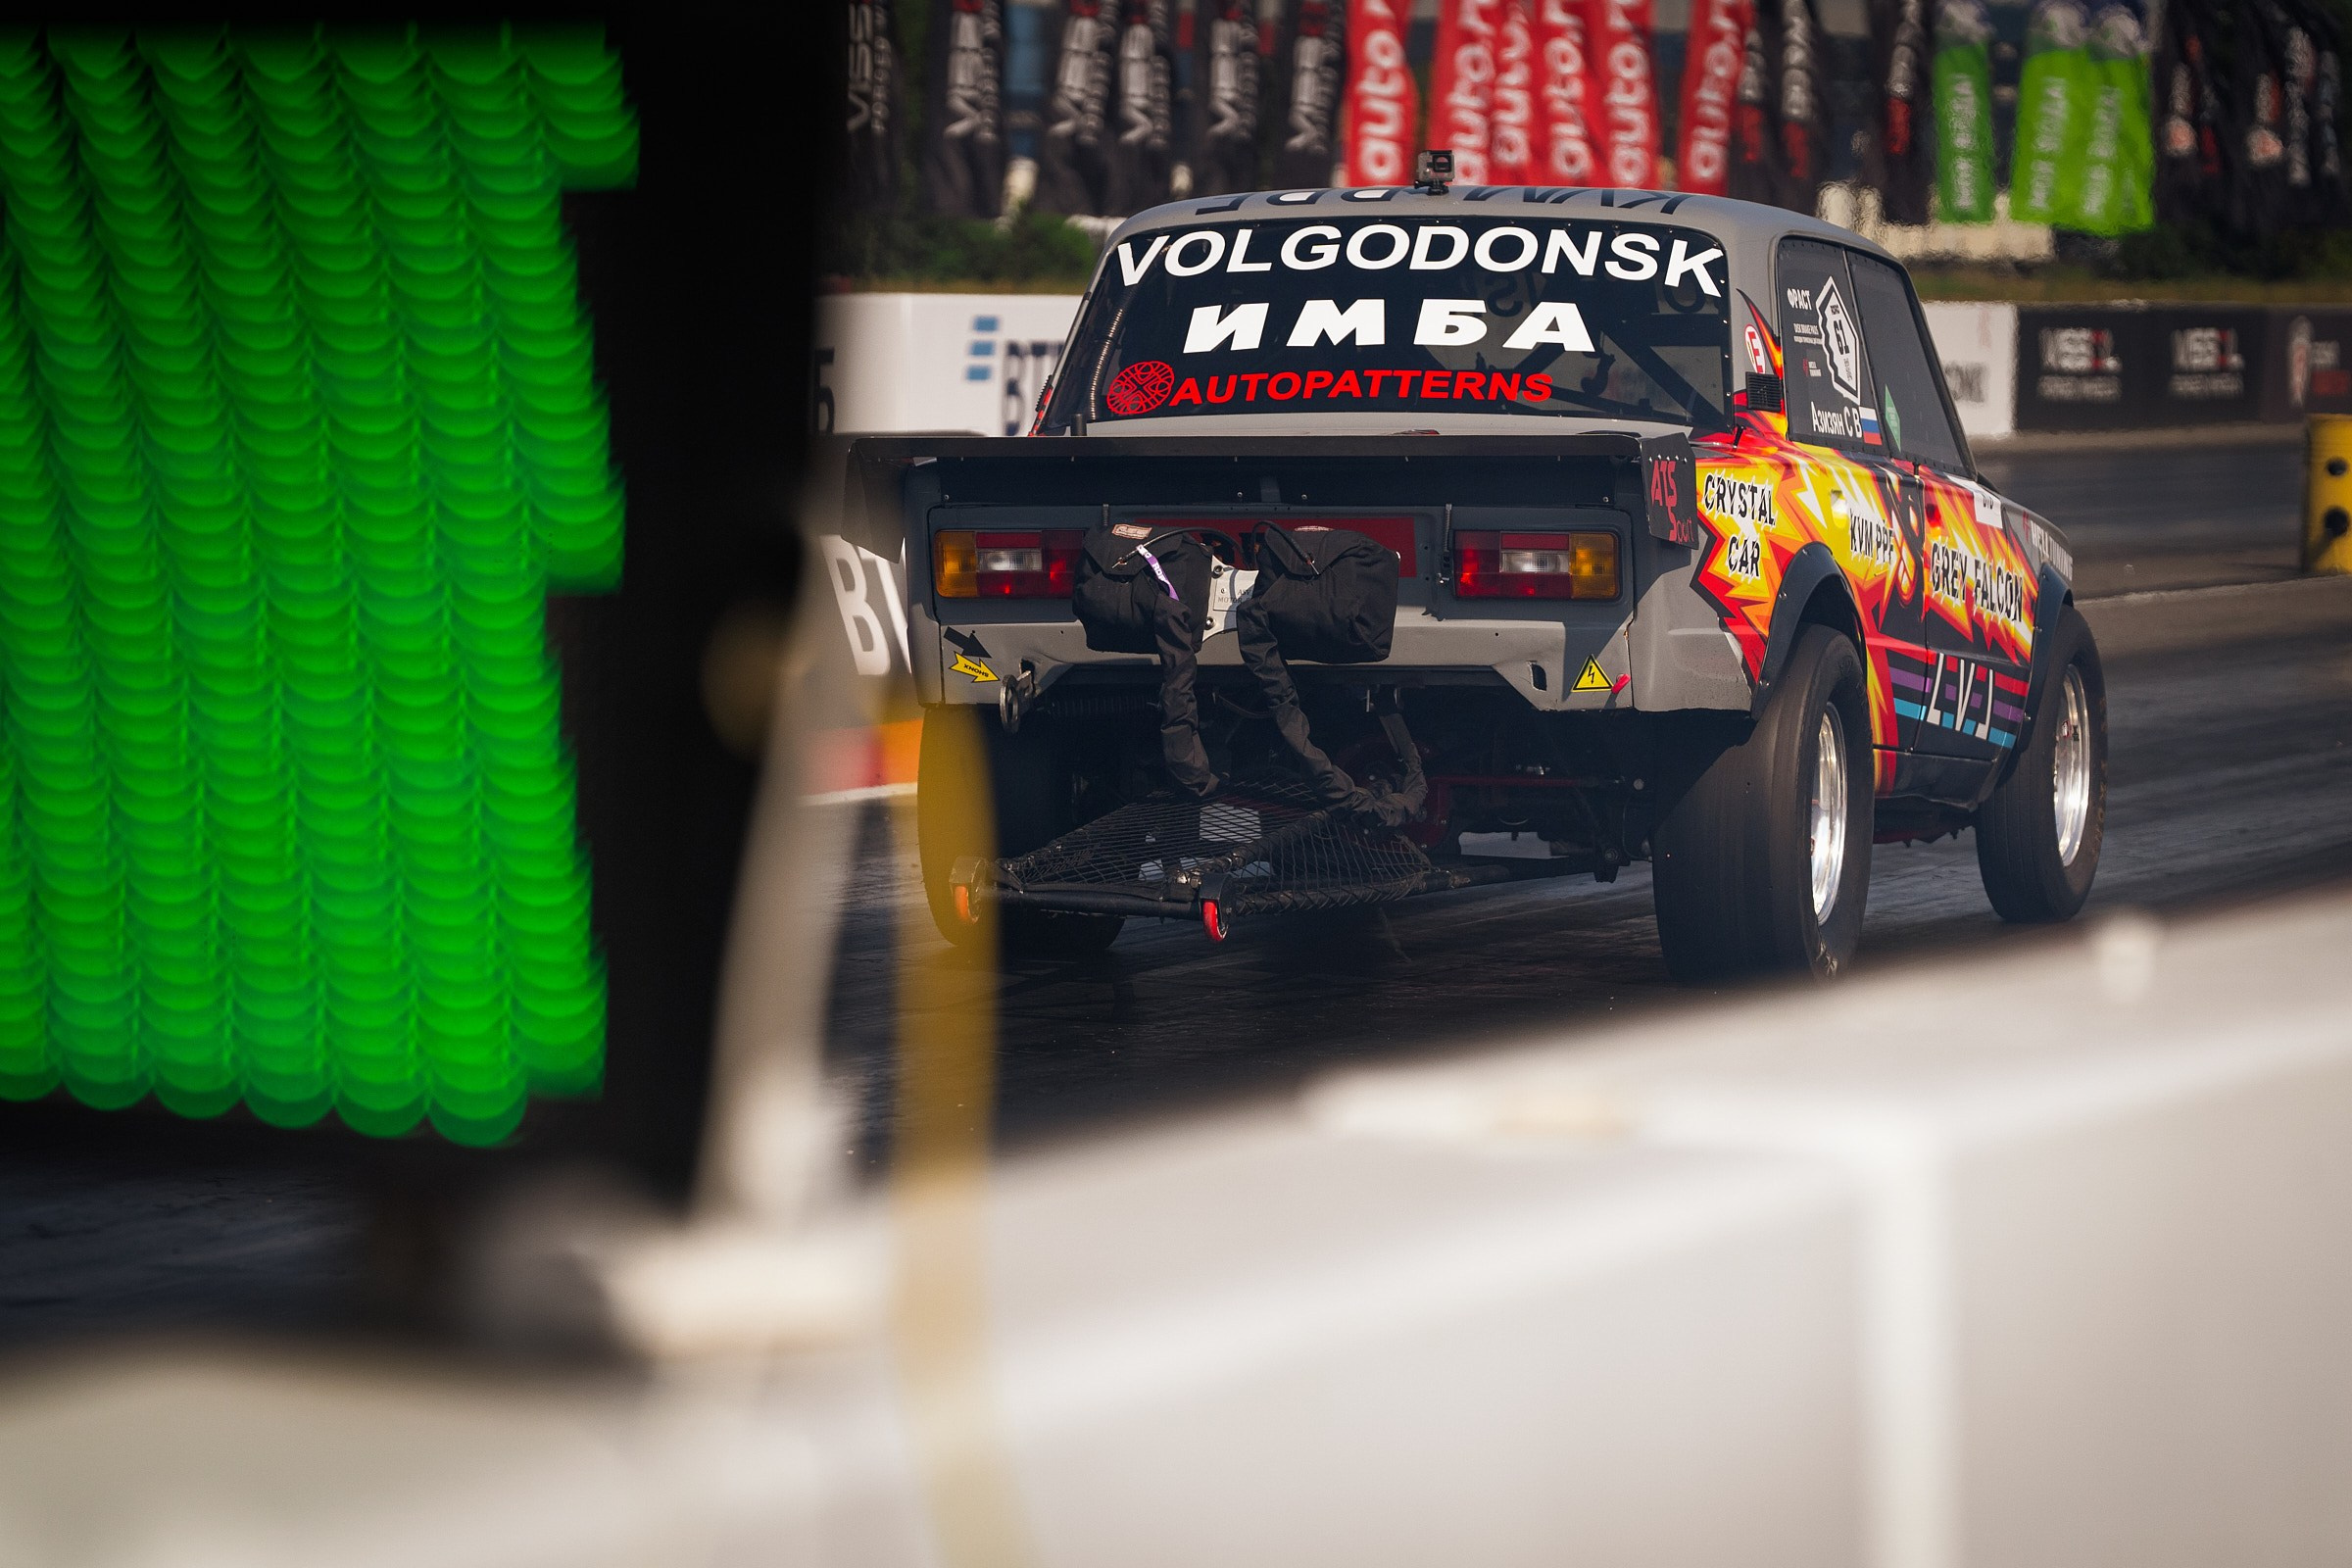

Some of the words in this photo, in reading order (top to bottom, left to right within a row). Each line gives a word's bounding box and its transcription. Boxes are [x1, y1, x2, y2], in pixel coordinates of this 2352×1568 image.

[847, 0, 873, 132] VISS
[1444, 0, 1496, 186] auto.r
[1117, 223, 1724, 298] VOLGODONSK
[1184, 299, 1594, 353] ИМБА
[1169, 369, 1553, 407] AUTOPATTERNS
[1703, 473, 1776, 526] CRYSTAL
[1728, 535, 1760, 577] CAR
[1931, 540, 1968, 601] GREY
[1974, 558, 2025, 622] FALCON
